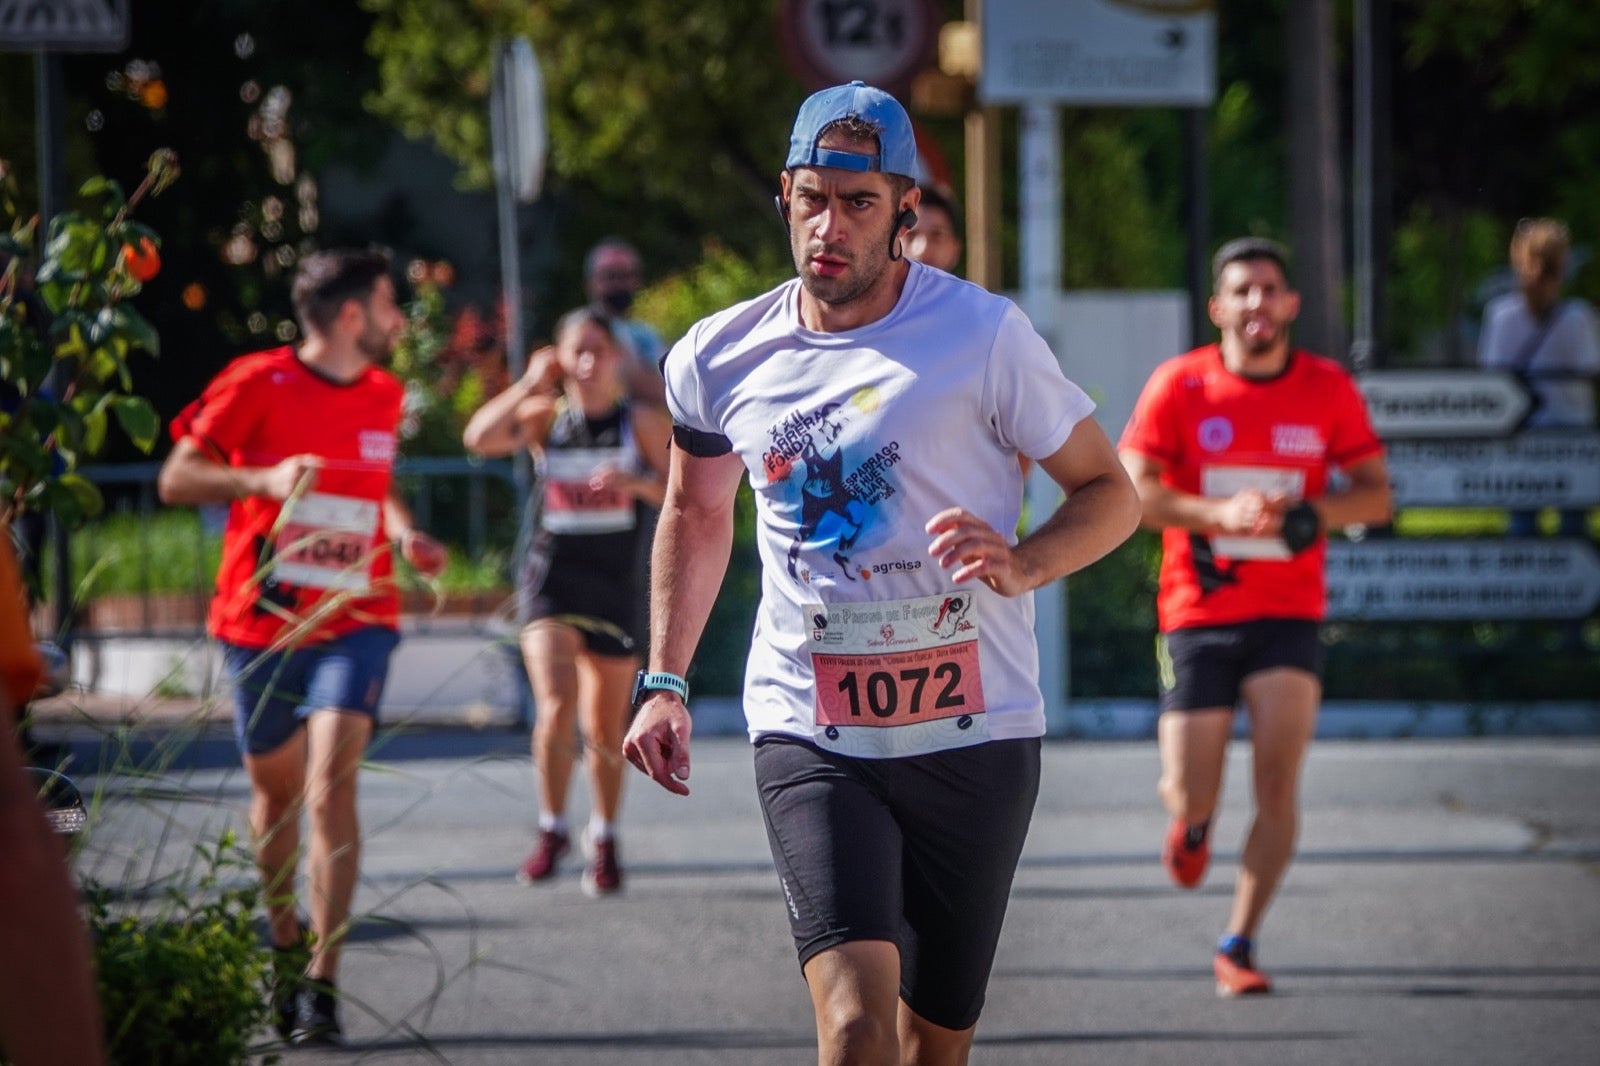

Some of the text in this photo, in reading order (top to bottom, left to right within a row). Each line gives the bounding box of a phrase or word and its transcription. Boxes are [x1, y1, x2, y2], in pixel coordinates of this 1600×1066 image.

[762, 410, 823, 462] CARRERA
[767, 433, 813, 473] FONDO
[840, 441, 899, 490] ESPARRAGO
[859, 452, 901, 488] HUETOR
[872, 559, 922, 574] agroisa
[837, 662, 965, 718] 1072
